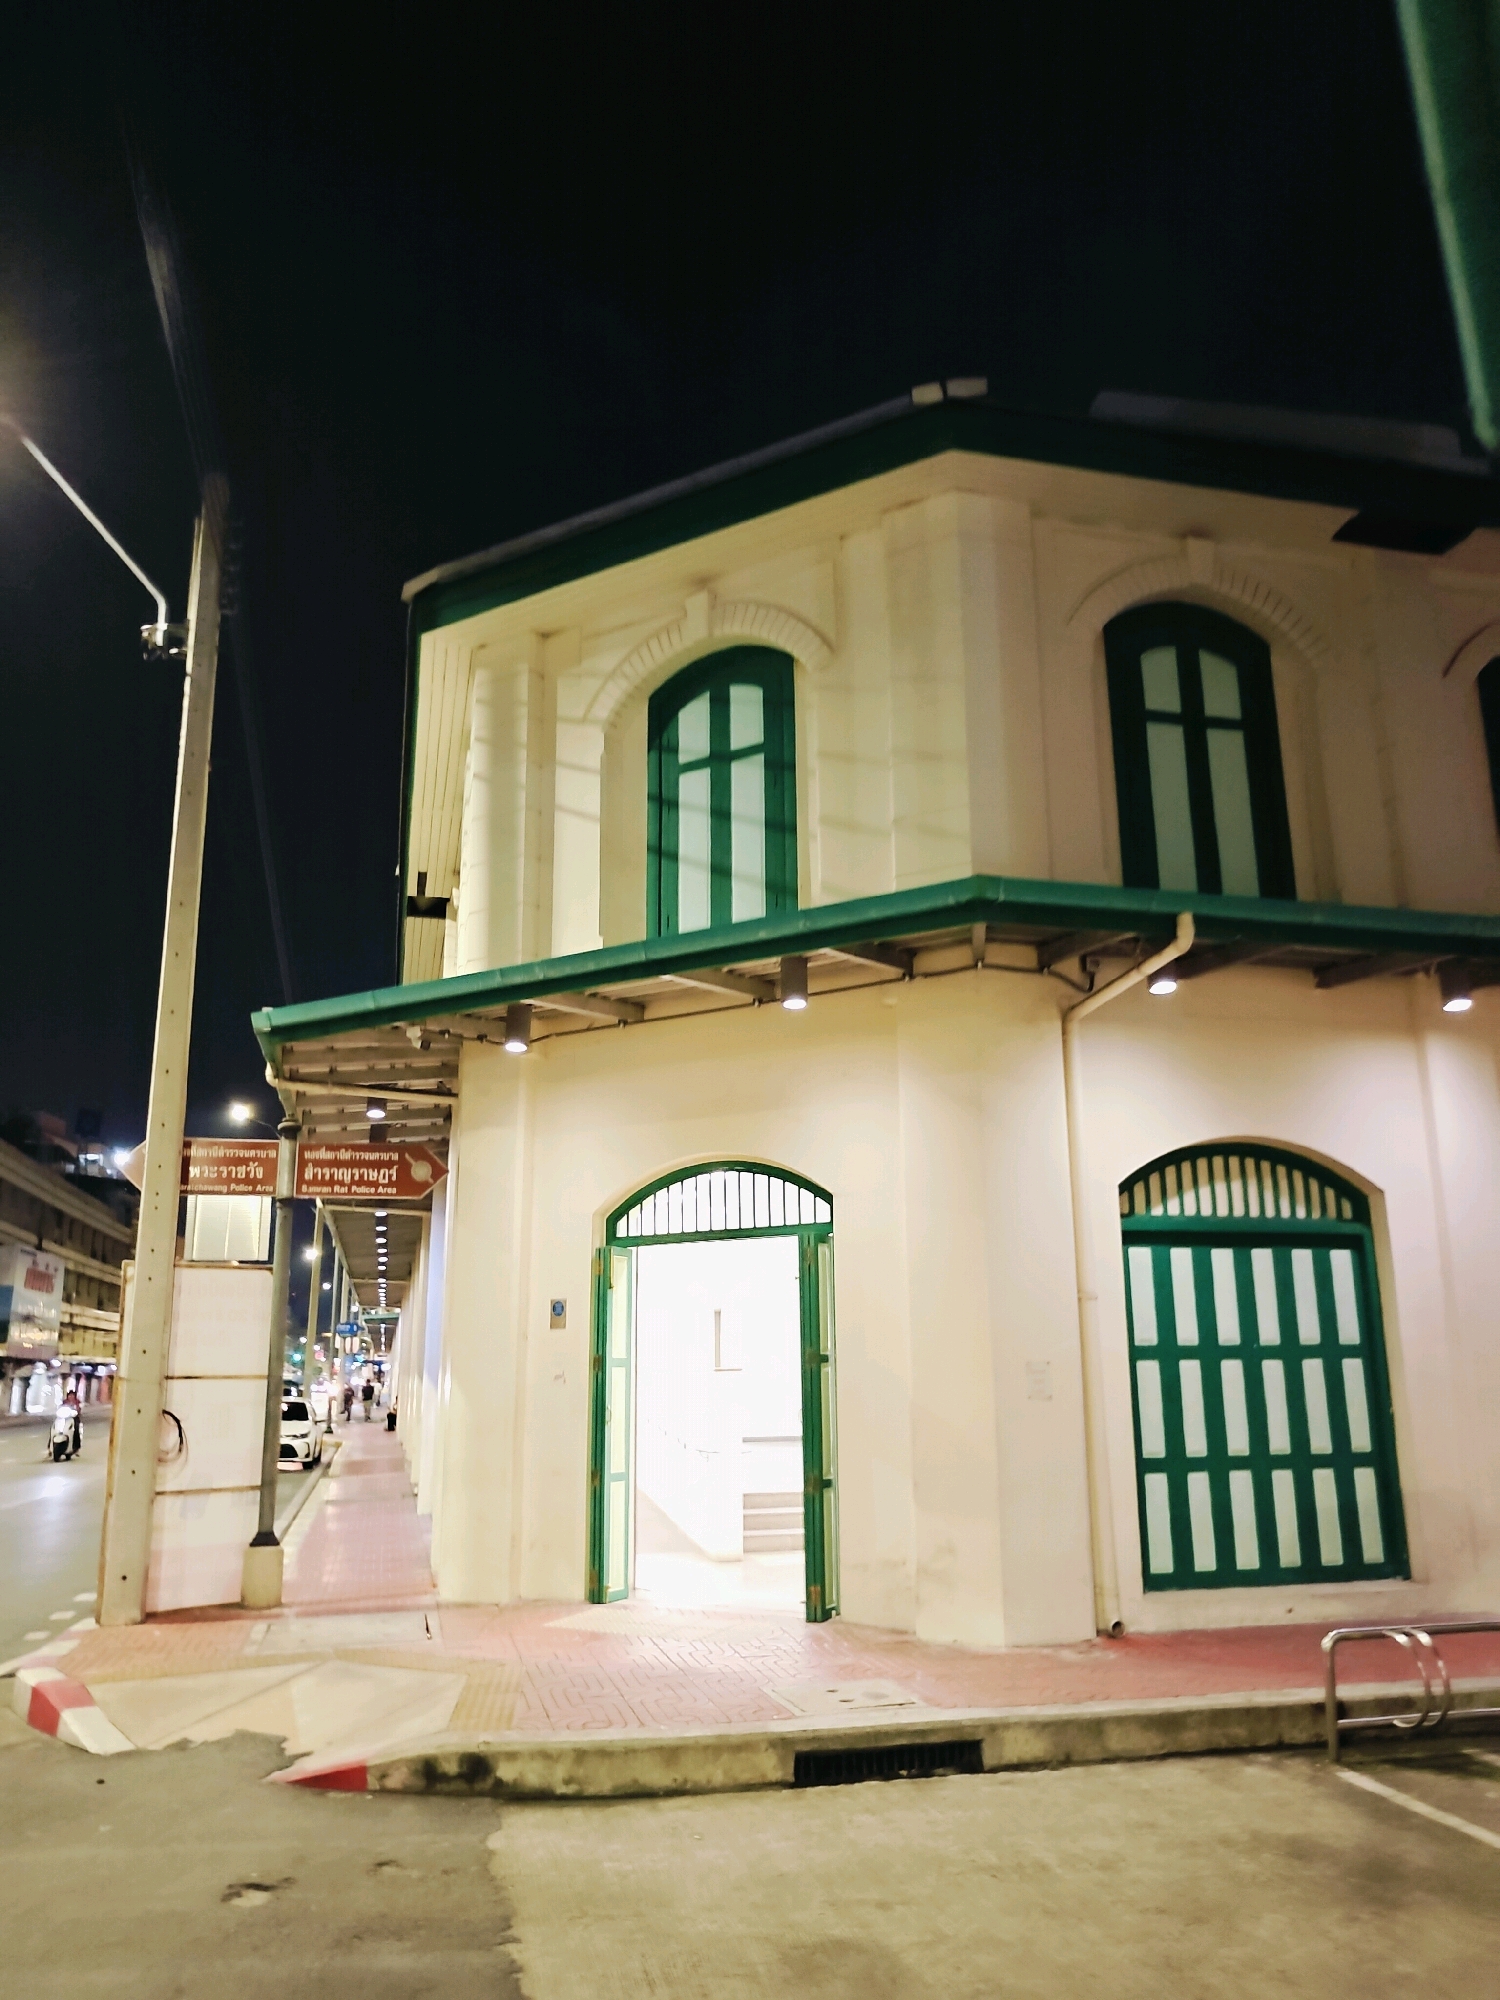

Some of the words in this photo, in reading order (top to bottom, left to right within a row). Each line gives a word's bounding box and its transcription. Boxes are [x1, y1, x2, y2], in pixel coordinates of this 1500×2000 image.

[189, 1161, 264, 1179] พระราชวัง
[304, 1162, 399, 1184] สำราญราษฎร์
[230, 1183, 253, 1192] Police
[256, 1184, 274, 1192] Area
[333, 1184, 348, 1194] Rat
[351, 1184, 375, 1194] Police
[377, 1185, 397, 1194] Area
